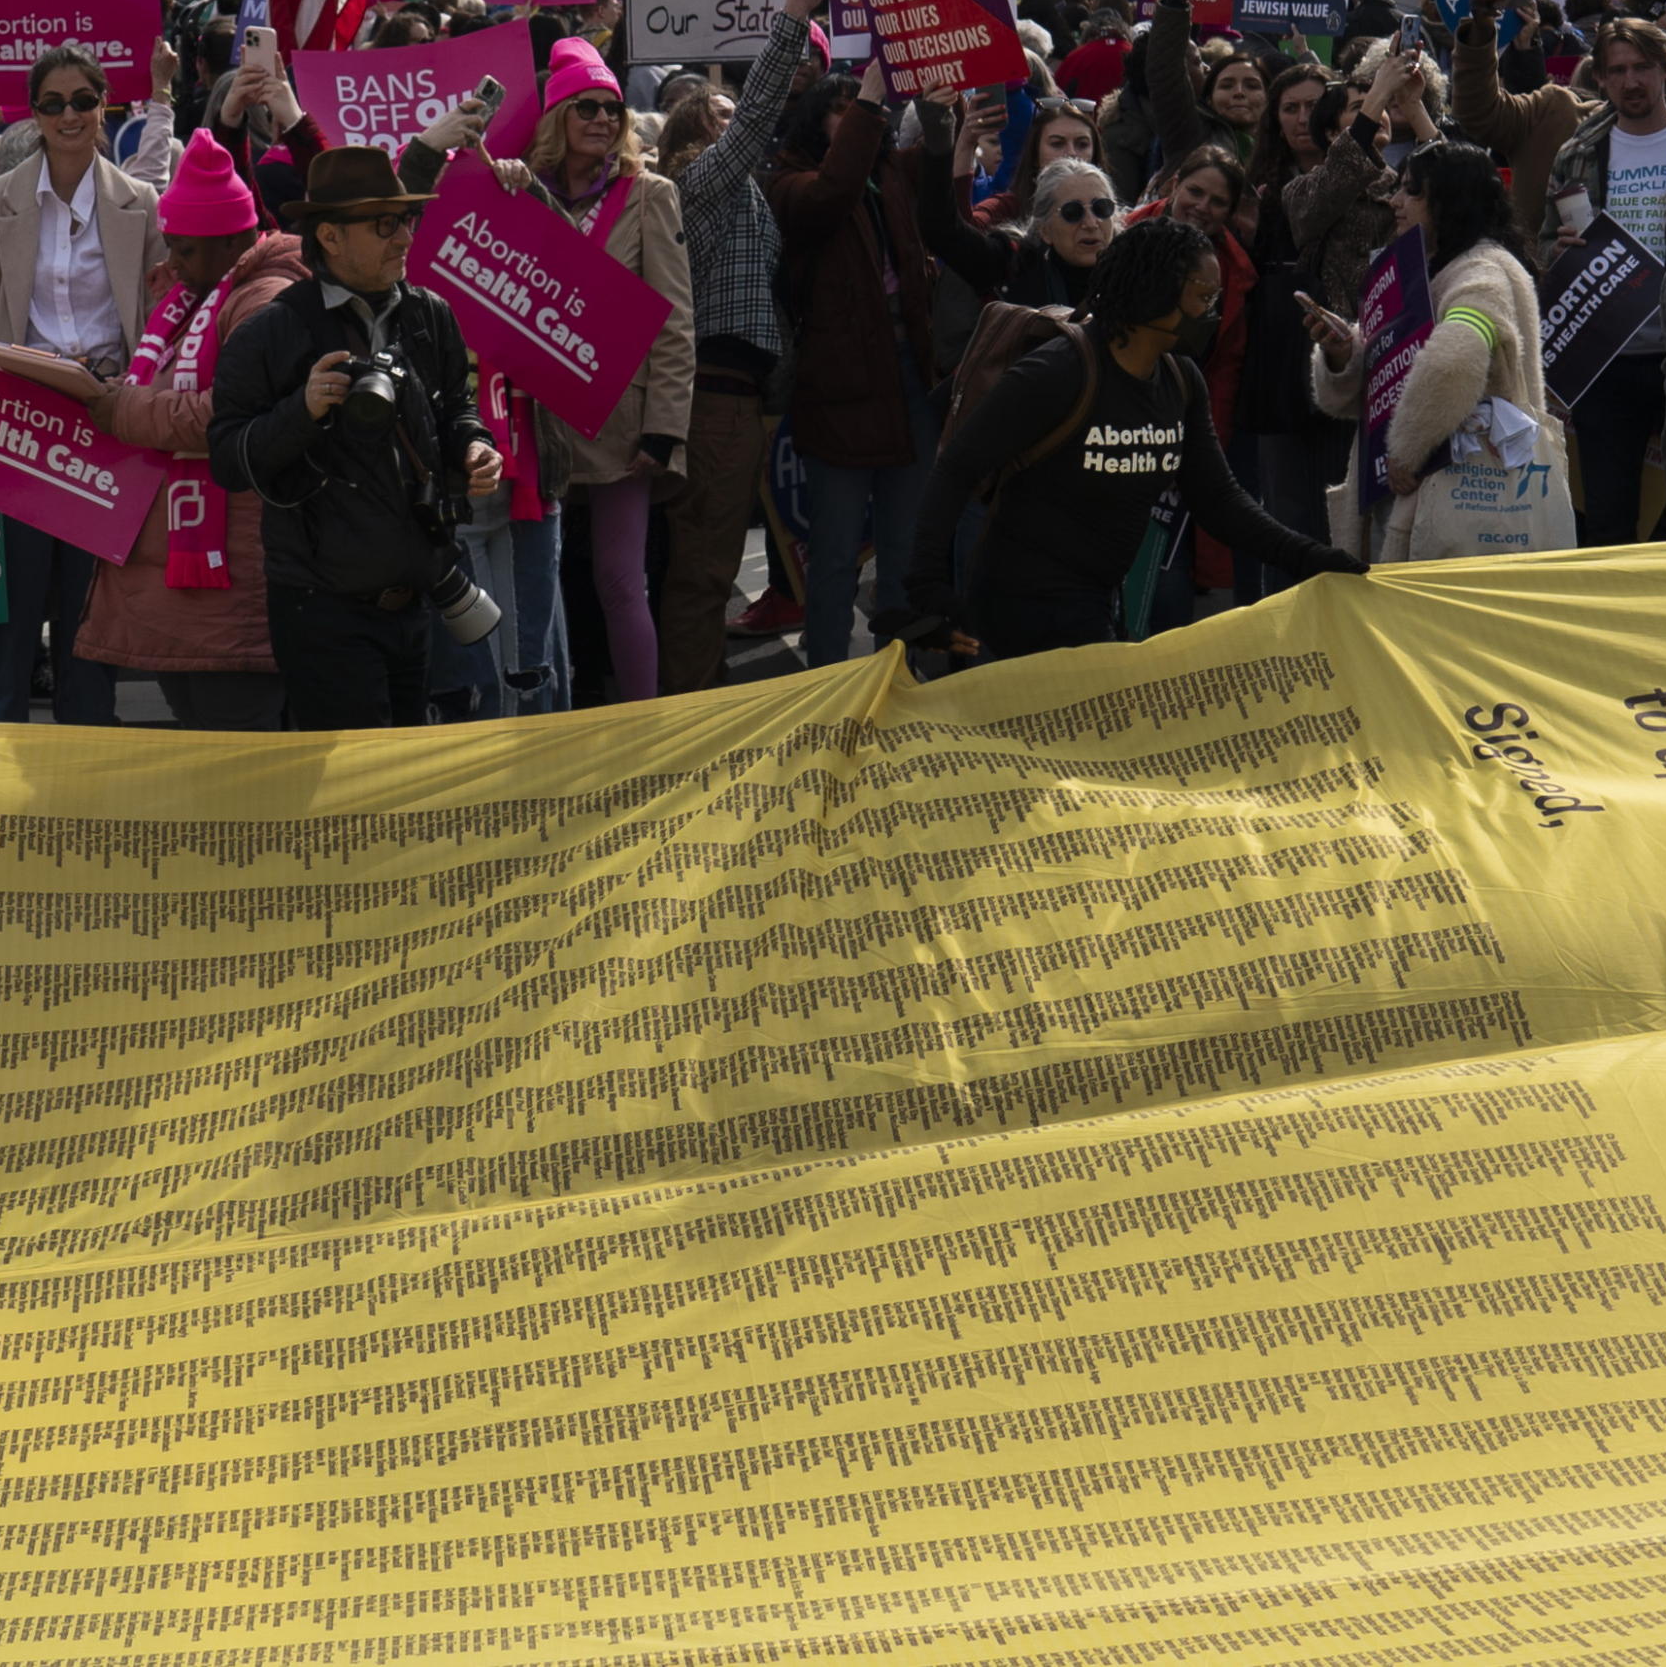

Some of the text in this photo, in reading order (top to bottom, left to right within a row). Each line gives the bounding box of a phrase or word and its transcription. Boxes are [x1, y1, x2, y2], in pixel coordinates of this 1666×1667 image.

[75, 11, 93, 32] is
[647, 6, 698, 36] Our
[875, 5, 941, 37] OUR LIVES
[1240, 0, 1329, 17] JEWISH VALUE
[883, 24, 992, 65] OUR DECISIONS
[336, 69, 436, 103] BANS
[891, 67, 916, 93] OUR
[338, 103, 410, 132] OFF
[453, 212, 586, 317] Abortion is
[437, 235, 599, 371] Health Care.
[1552, 254, 1640, 353] HEALTH CARE
[73, 418, 94, 447] is
[1085, 423, 1176, 445] Abortion
[46, 444, 119, 496] Care.
[1084, 451, 1156, 473] Health
[1445, 463, 1509, 478] Religious
[1451, 488, 1499, 502] Center
[1460, 476, 1505, 491] Action
[1466, 503, 1498, 511] Reform
[1500, 504, 1532, 513] Judaism
[1478, 533, 1529, 545] rac.org
[1464, 701, 1604, 829] Signed,
